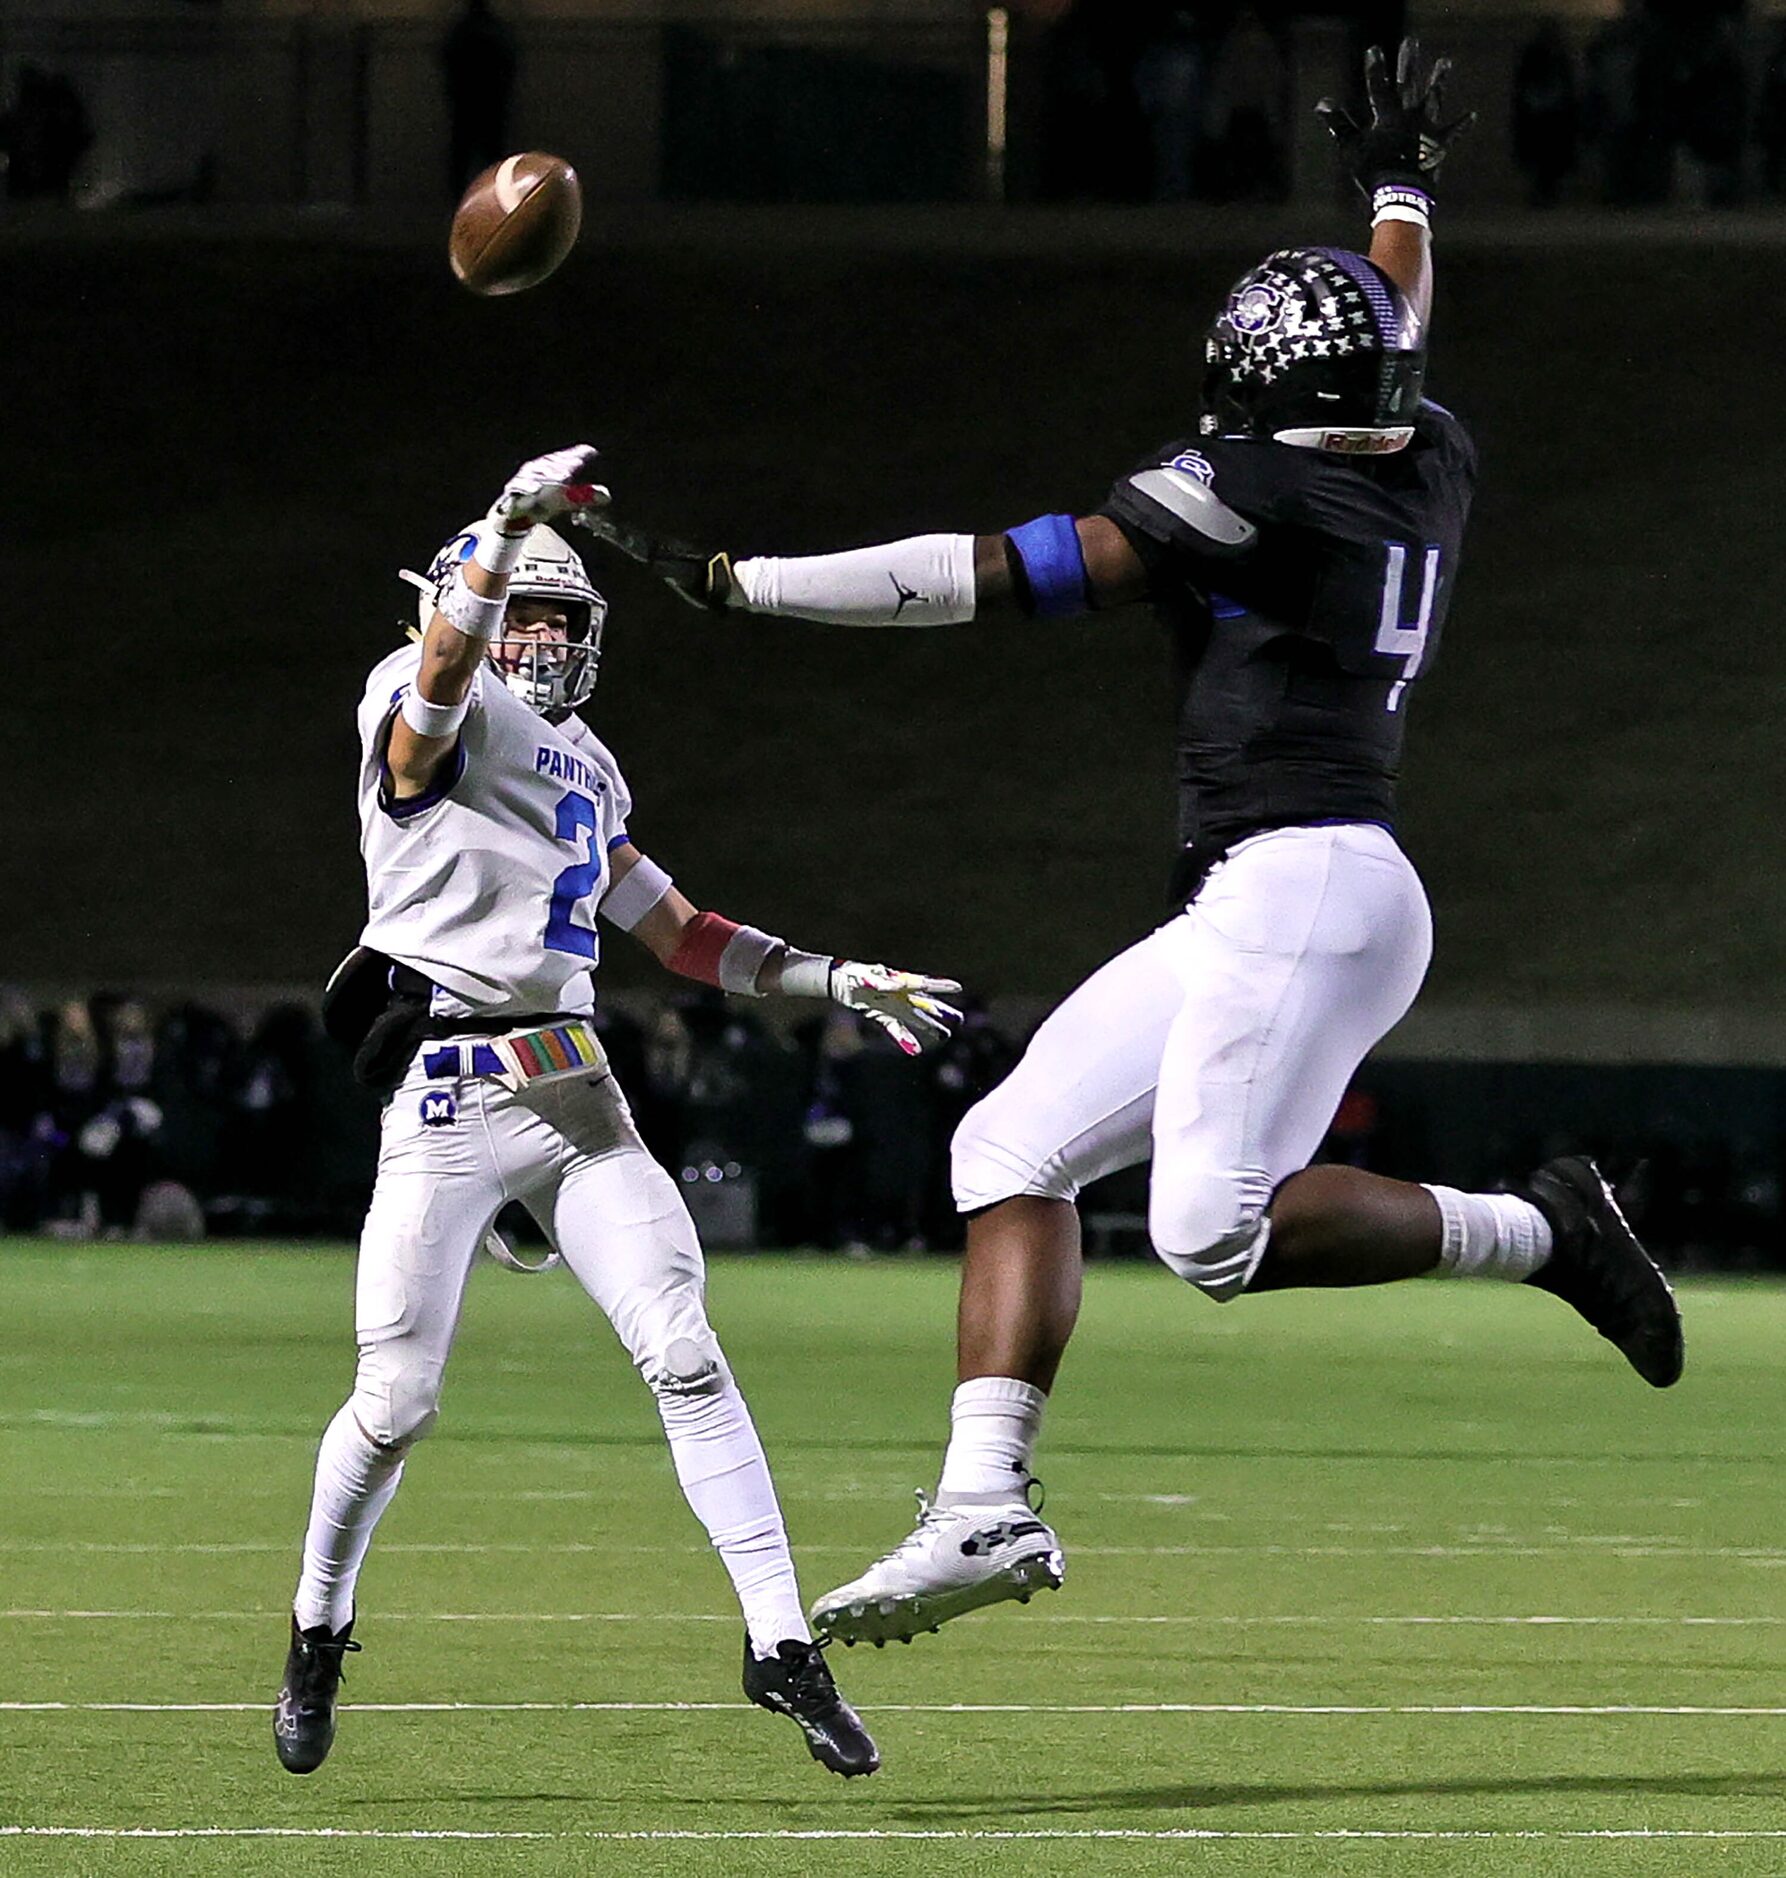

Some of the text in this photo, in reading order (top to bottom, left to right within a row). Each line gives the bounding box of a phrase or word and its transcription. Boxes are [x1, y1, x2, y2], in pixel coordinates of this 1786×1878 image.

[1373, 544, 1440, 712] 4
[544, 790, 602, 961] 2
[425, 1098, 449, 1119] M
